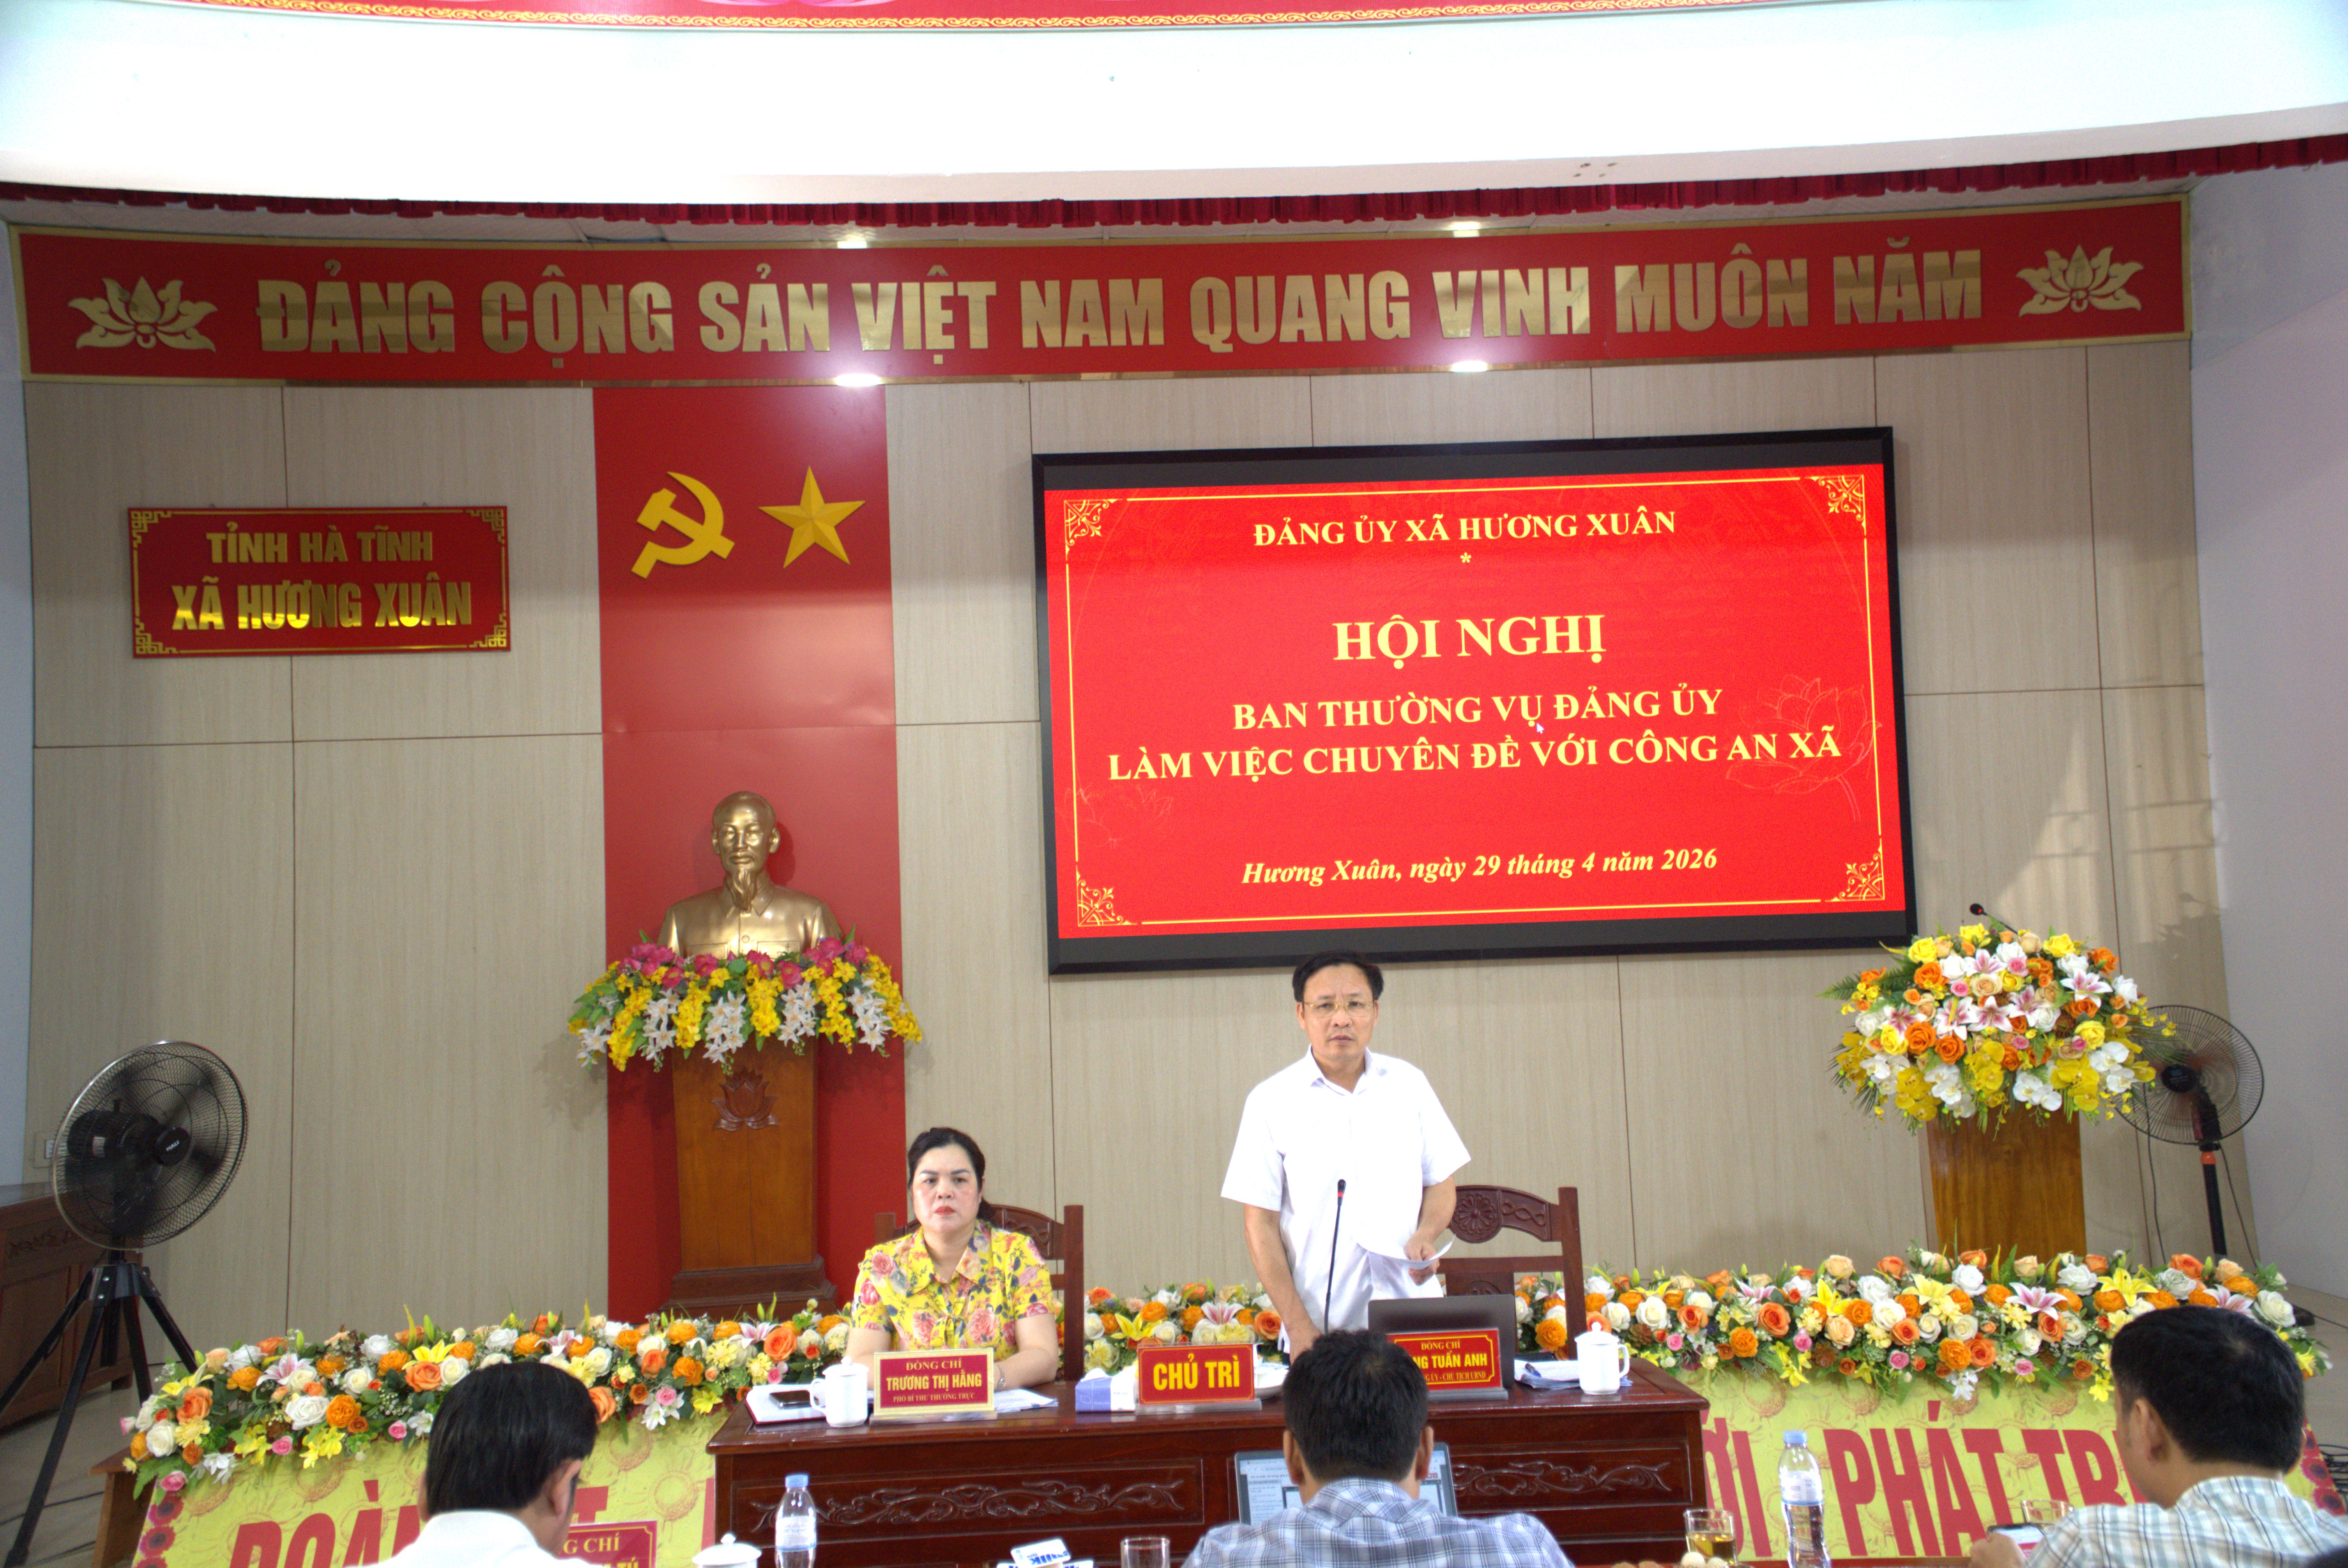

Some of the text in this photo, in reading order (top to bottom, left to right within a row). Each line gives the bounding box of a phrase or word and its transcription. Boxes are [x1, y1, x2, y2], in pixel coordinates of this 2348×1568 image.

[256, 236, 1982, 368] ĐẢNG CỘNG SẢN VIỆT NAM QUANG VINH MUÔN NĂM
[207, 522, 433, 563] TỈNH HÀ TĨNH
[1253, 505, 1675, 546] ĐẢNG ỦY XÃ HƯƠNG XUÂN
[172, 572, 472, 630] XÃ HƯƠNG XUÂN
[1332, 614, 1606, 669] HỘI NGHỊ
[1233, 683, 1722, 729] BAN THƯỜNG VỤ ĐẢNG ỦY
[1108, 725, 1842, 782] LÀM VIỆC CHUYÊN ĐỀ VỚI CÔNG AN XÃ
[1241, 848, 1717, 887] Hương Xuân, ngày 29 tháng 4 năm 2026
[941, 1358, 962, 1369] CHÍ
[1413, 1350, 1488, 1369] NG TUẤN ANH
[1445, 1339, 1460, 1349] CHÍ
[886, 1369, 982, 1391] TRƯƠNG THỊ HẰNG
[1153, 1353, 1240, 1391] CHỦ TRÌ
[1823, 1400, 2013, 1557] PHÁT
[584, 1532, 620, 1554] CHÍ
